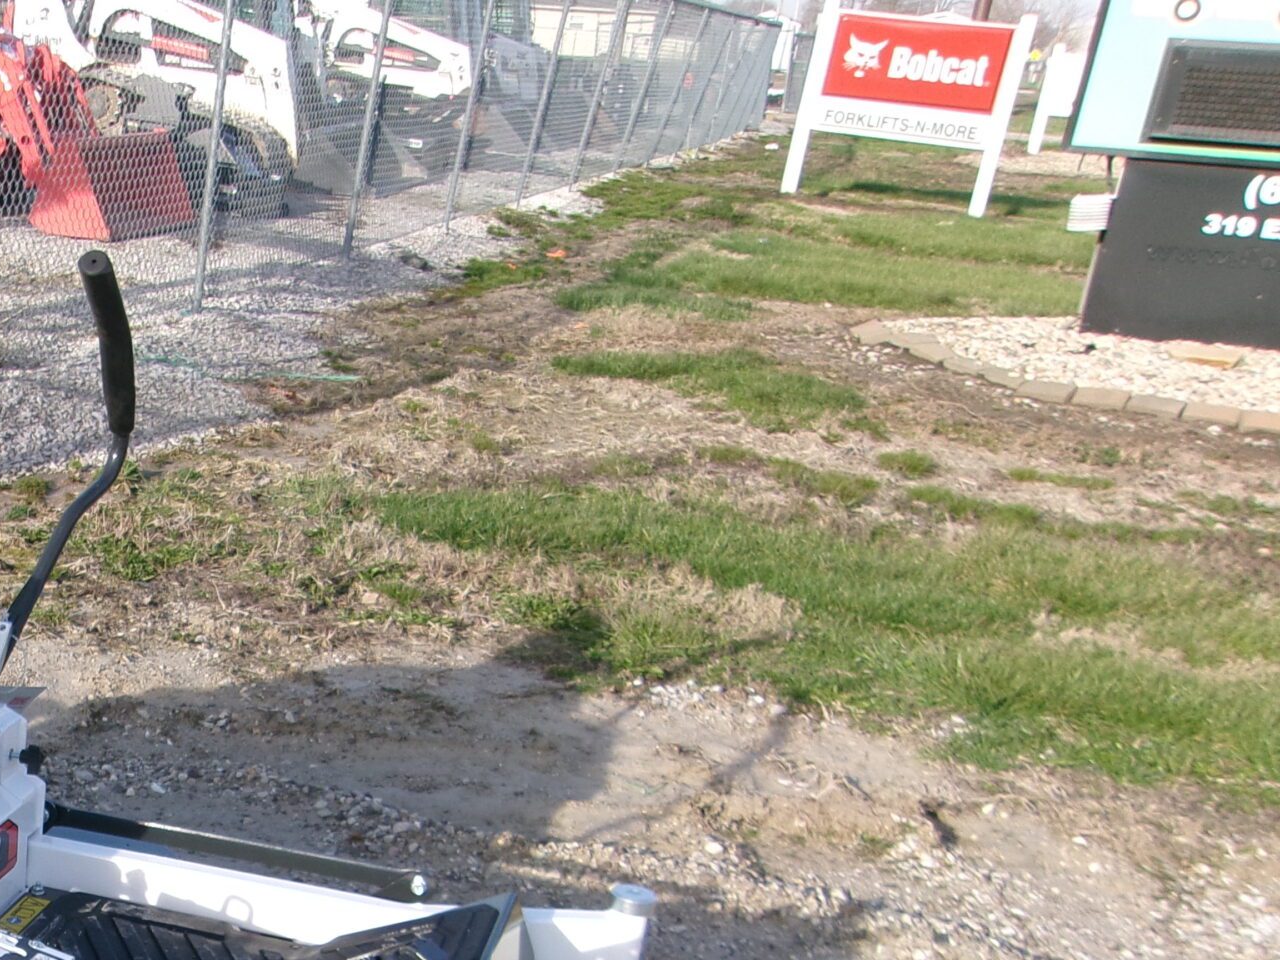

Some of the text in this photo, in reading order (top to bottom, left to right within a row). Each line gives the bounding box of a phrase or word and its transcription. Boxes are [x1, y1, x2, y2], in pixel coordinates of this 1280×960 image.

[886, 46, 990, 88] Bobcat
[824, 109, 978, 140] FORKLIFTS-N-MORE
[1200, 212, 1258, 238] 319
